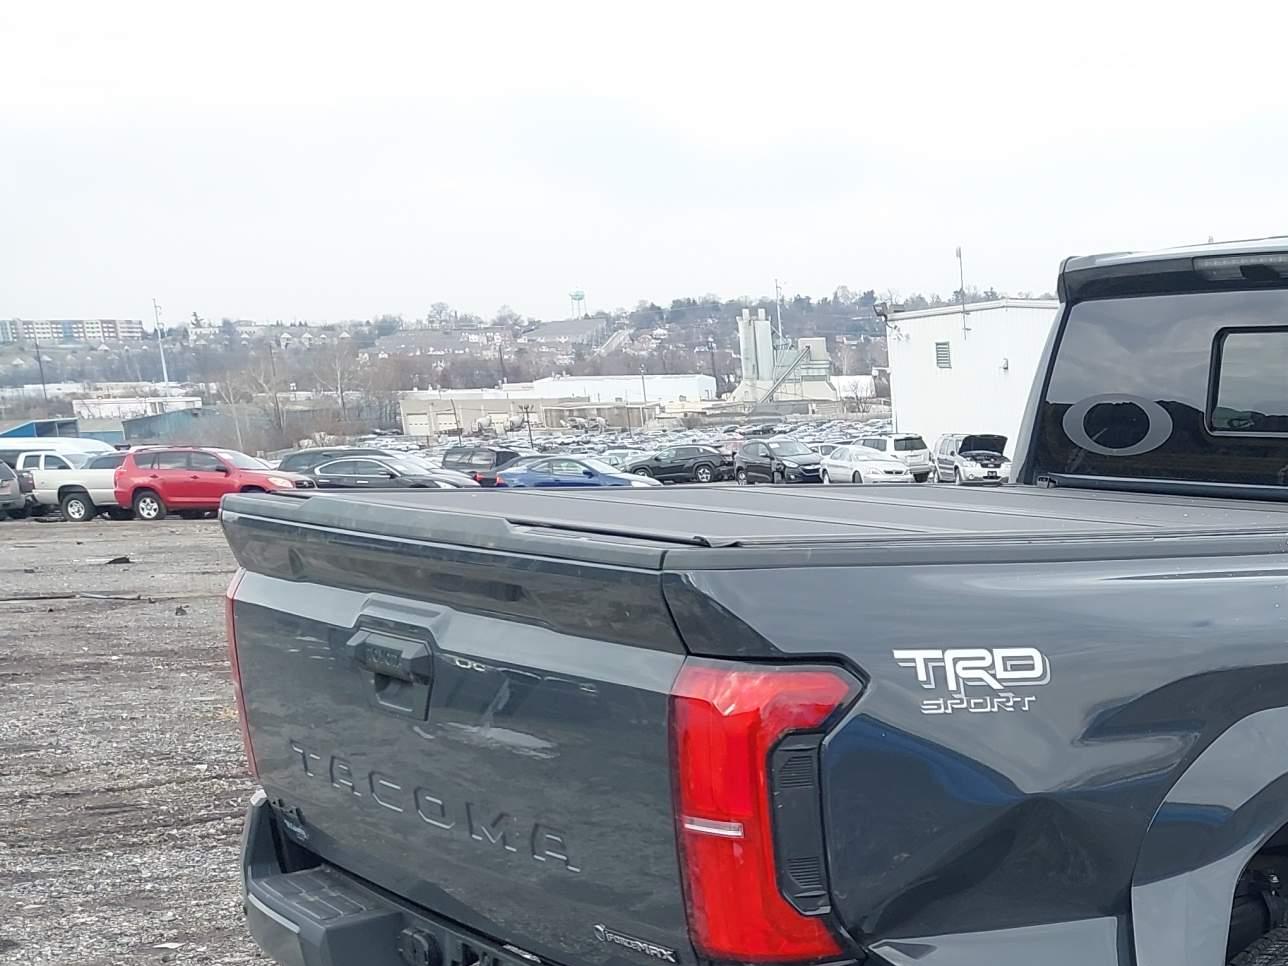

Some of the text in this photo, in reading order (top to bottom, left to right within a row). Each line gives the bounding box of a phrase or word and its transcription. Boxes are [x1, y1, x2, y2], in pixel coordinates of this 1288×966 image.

[892, 647, 1051, 693] TRD
[920, 695, 1037, 715] SPORT
[290, 739, 581, 872] TACOMA
